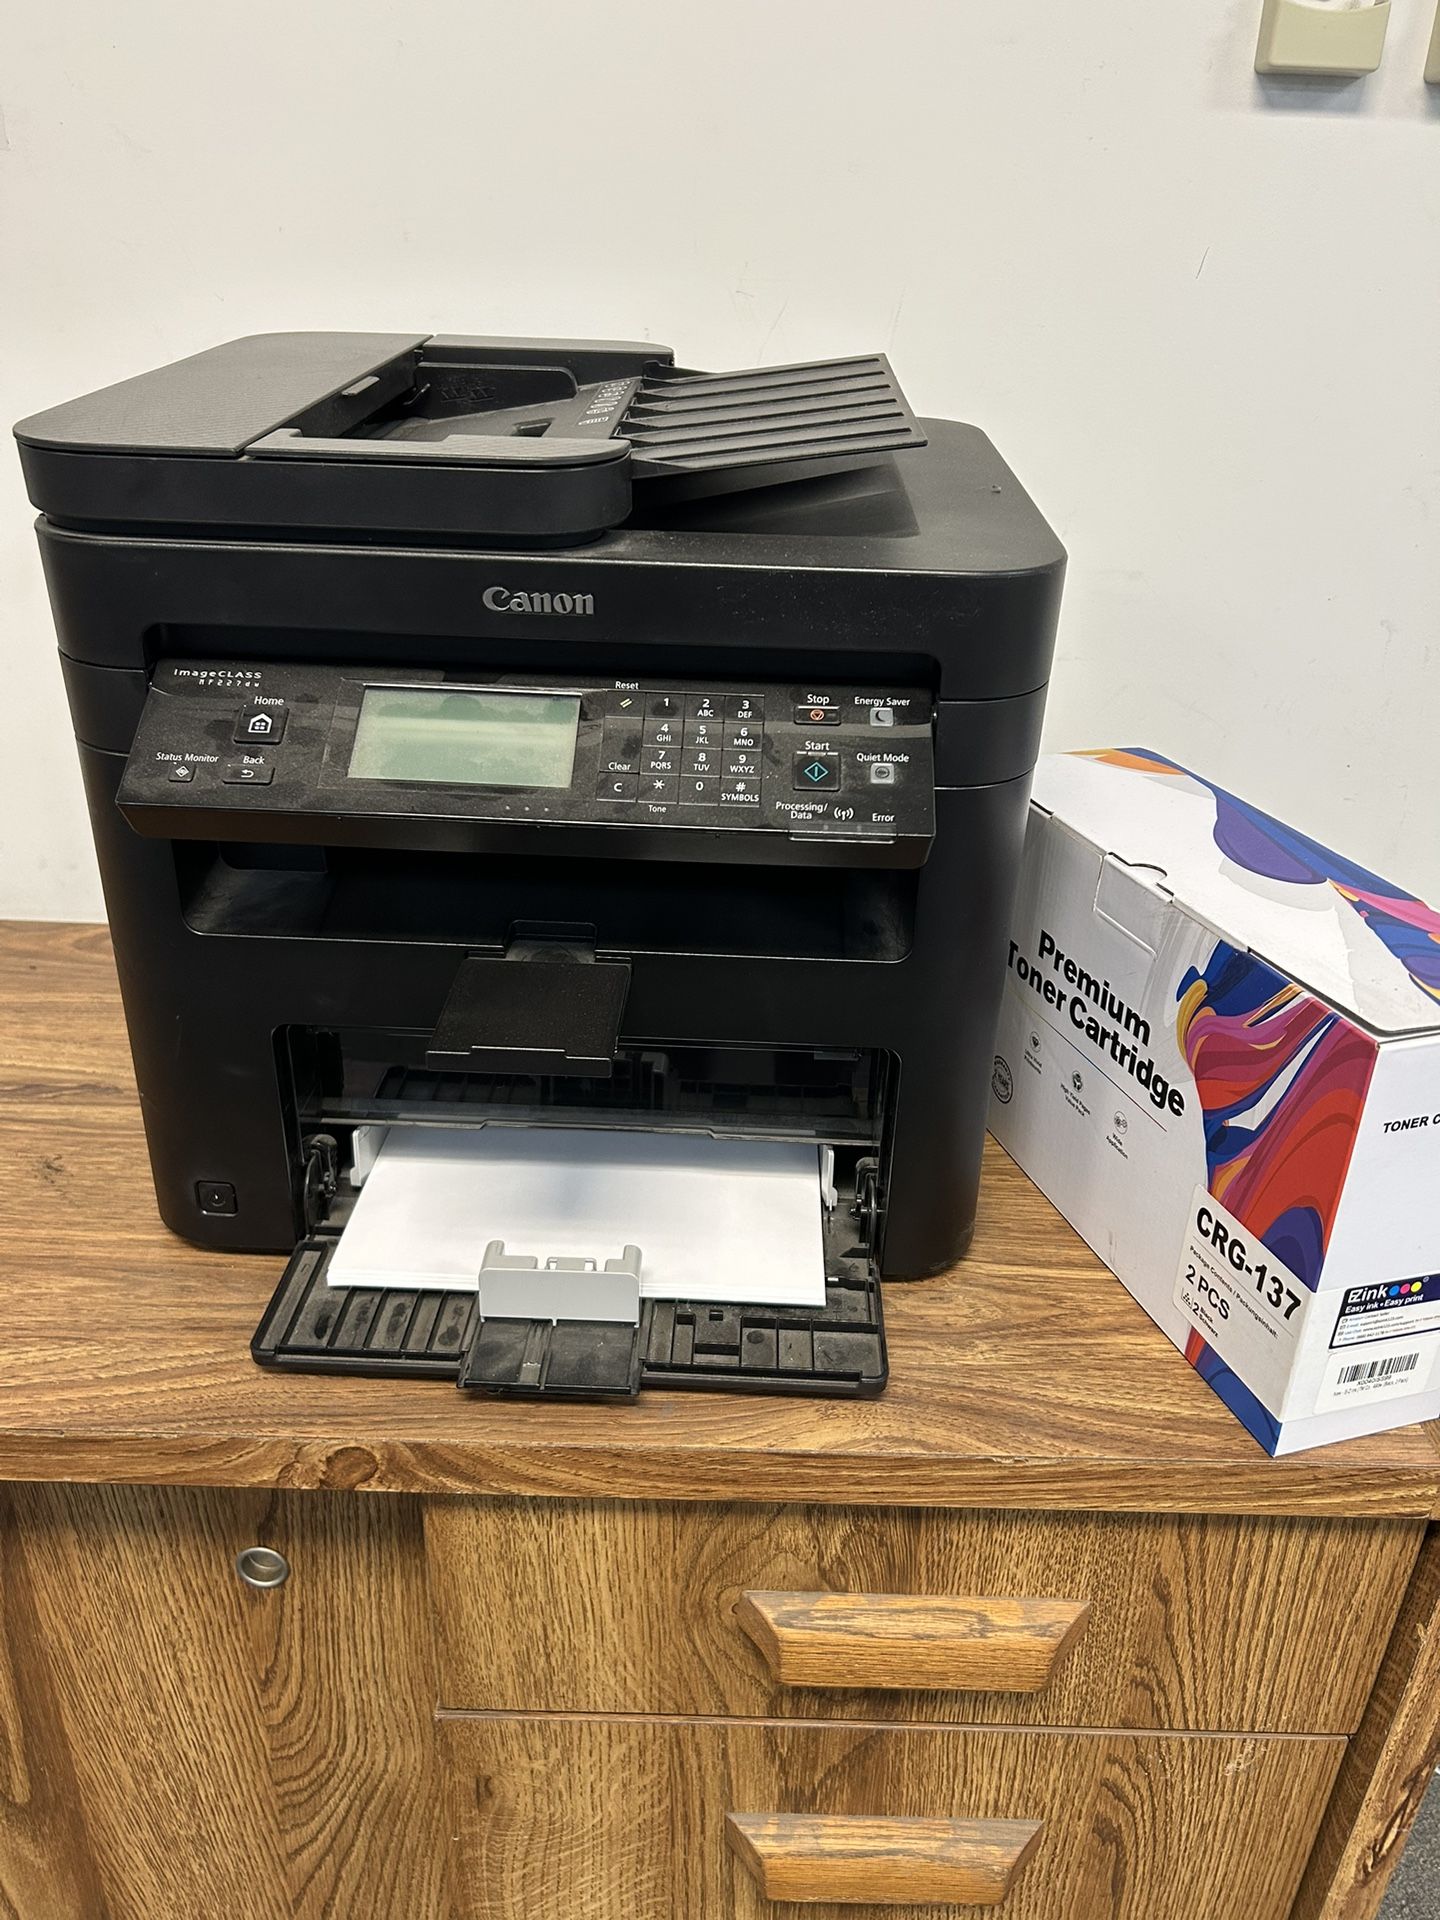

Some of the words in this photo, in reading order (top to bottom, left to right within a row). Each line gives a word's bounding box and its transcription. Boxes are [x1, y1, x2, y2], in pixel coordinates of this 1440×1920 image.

[482, 586, 594, 615] Canon
[615, 681, 639, 690] Reset
[254, 696, 284, 706] Home
[663, 698, 670, 706] 1
[702, 699, 710, 708] 2
[807, 694, 829, 705] Stop
[854, 696, 884, 708] Energy
[885, 697, 910, 706] Saver
[742, 700, 750, 709] 3
[697, 709, 714, 717] ABC
[738, 710, 752, 719] DEF
[661, 724, 668, 732] 4
[699, 726, 706, 734] 5
[740, 727, 748, 736] 6
[656, 734, 671, 742] GHI
[695, 736, 709, 744] JKL
[734, 737, 753, 746] MNO
[805, 741, 829, 751] Start
[156, 752, 182, 761] Status
[184, 753, 219, 762] Monitor
[658, 751, 666, 759] 7
[698, 753, 706, 762] 8
[739, 754, 746, 763] 9
[856, 753, 883, 763] Quiet
[885, 754, 909, 763] Mode
[243, 755, 265, 765] Back
[608, 762, 631, 771] Clear
[650, 761, 671, 770] PQRS
[693, 762, 710, 771] TUV
[730, 765, 754, 773] WXYZ
[736, 782, 746, 792] #
[721, 793, 759, 803] SYMBOLS
[648, 804, 667, 813] Tone
[775, 802, 828, 814] Processing/
[791, 810, 812, 820] Data
[872, 813, 894, 822] Error
[1038, 929, 1150, 1047] Premium
[1007, 940, 1067, 1012] Toner
[1070, 996, 1185, 1117] Cartridge
[1383, 1116, 1429, 1134] TONER
[1196, 1207, 1302, 1321] CRG-137
[1185, 1264, 1196, 1285] 2
[1197, 1275, 1230, 1320] PCS
[1192, 1301, 1200, 1316] 2
[1345, 1304, 1366, 1314] Easy
[1366, 1301, 1378, 1310] ink
[1384, 1297, 1404, 1308] Easy
[1404, 1294, 1424, 1305] print
